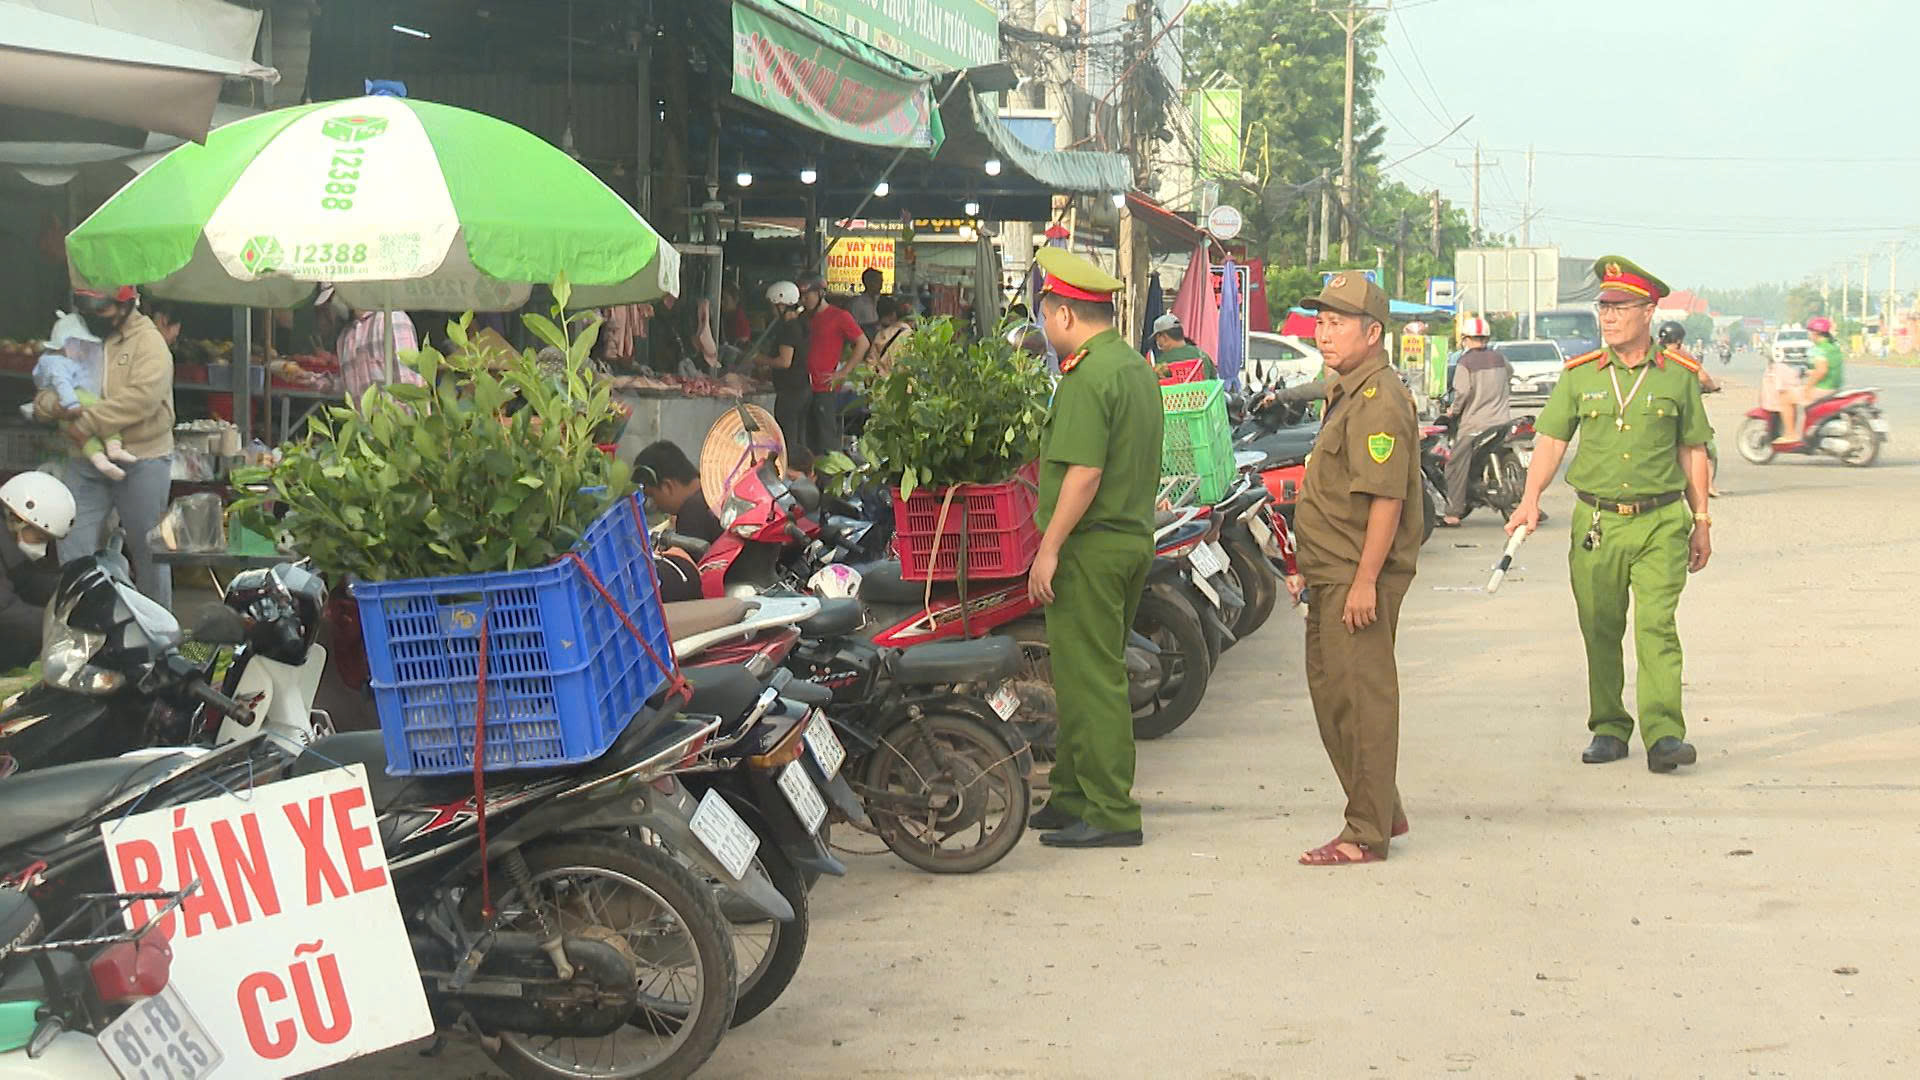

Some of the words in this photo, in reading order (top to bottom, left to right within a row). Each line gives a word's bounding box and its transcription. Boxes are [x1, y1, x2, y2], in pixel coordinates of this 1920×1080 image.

[321, 147, 365, 210] 12388
[293, 243, 368, 264] 12388
[116, 807, 281, 939] BÁN
[282, 787, 387, 905] XE
[237, 939, 352, 1059] CŨ
